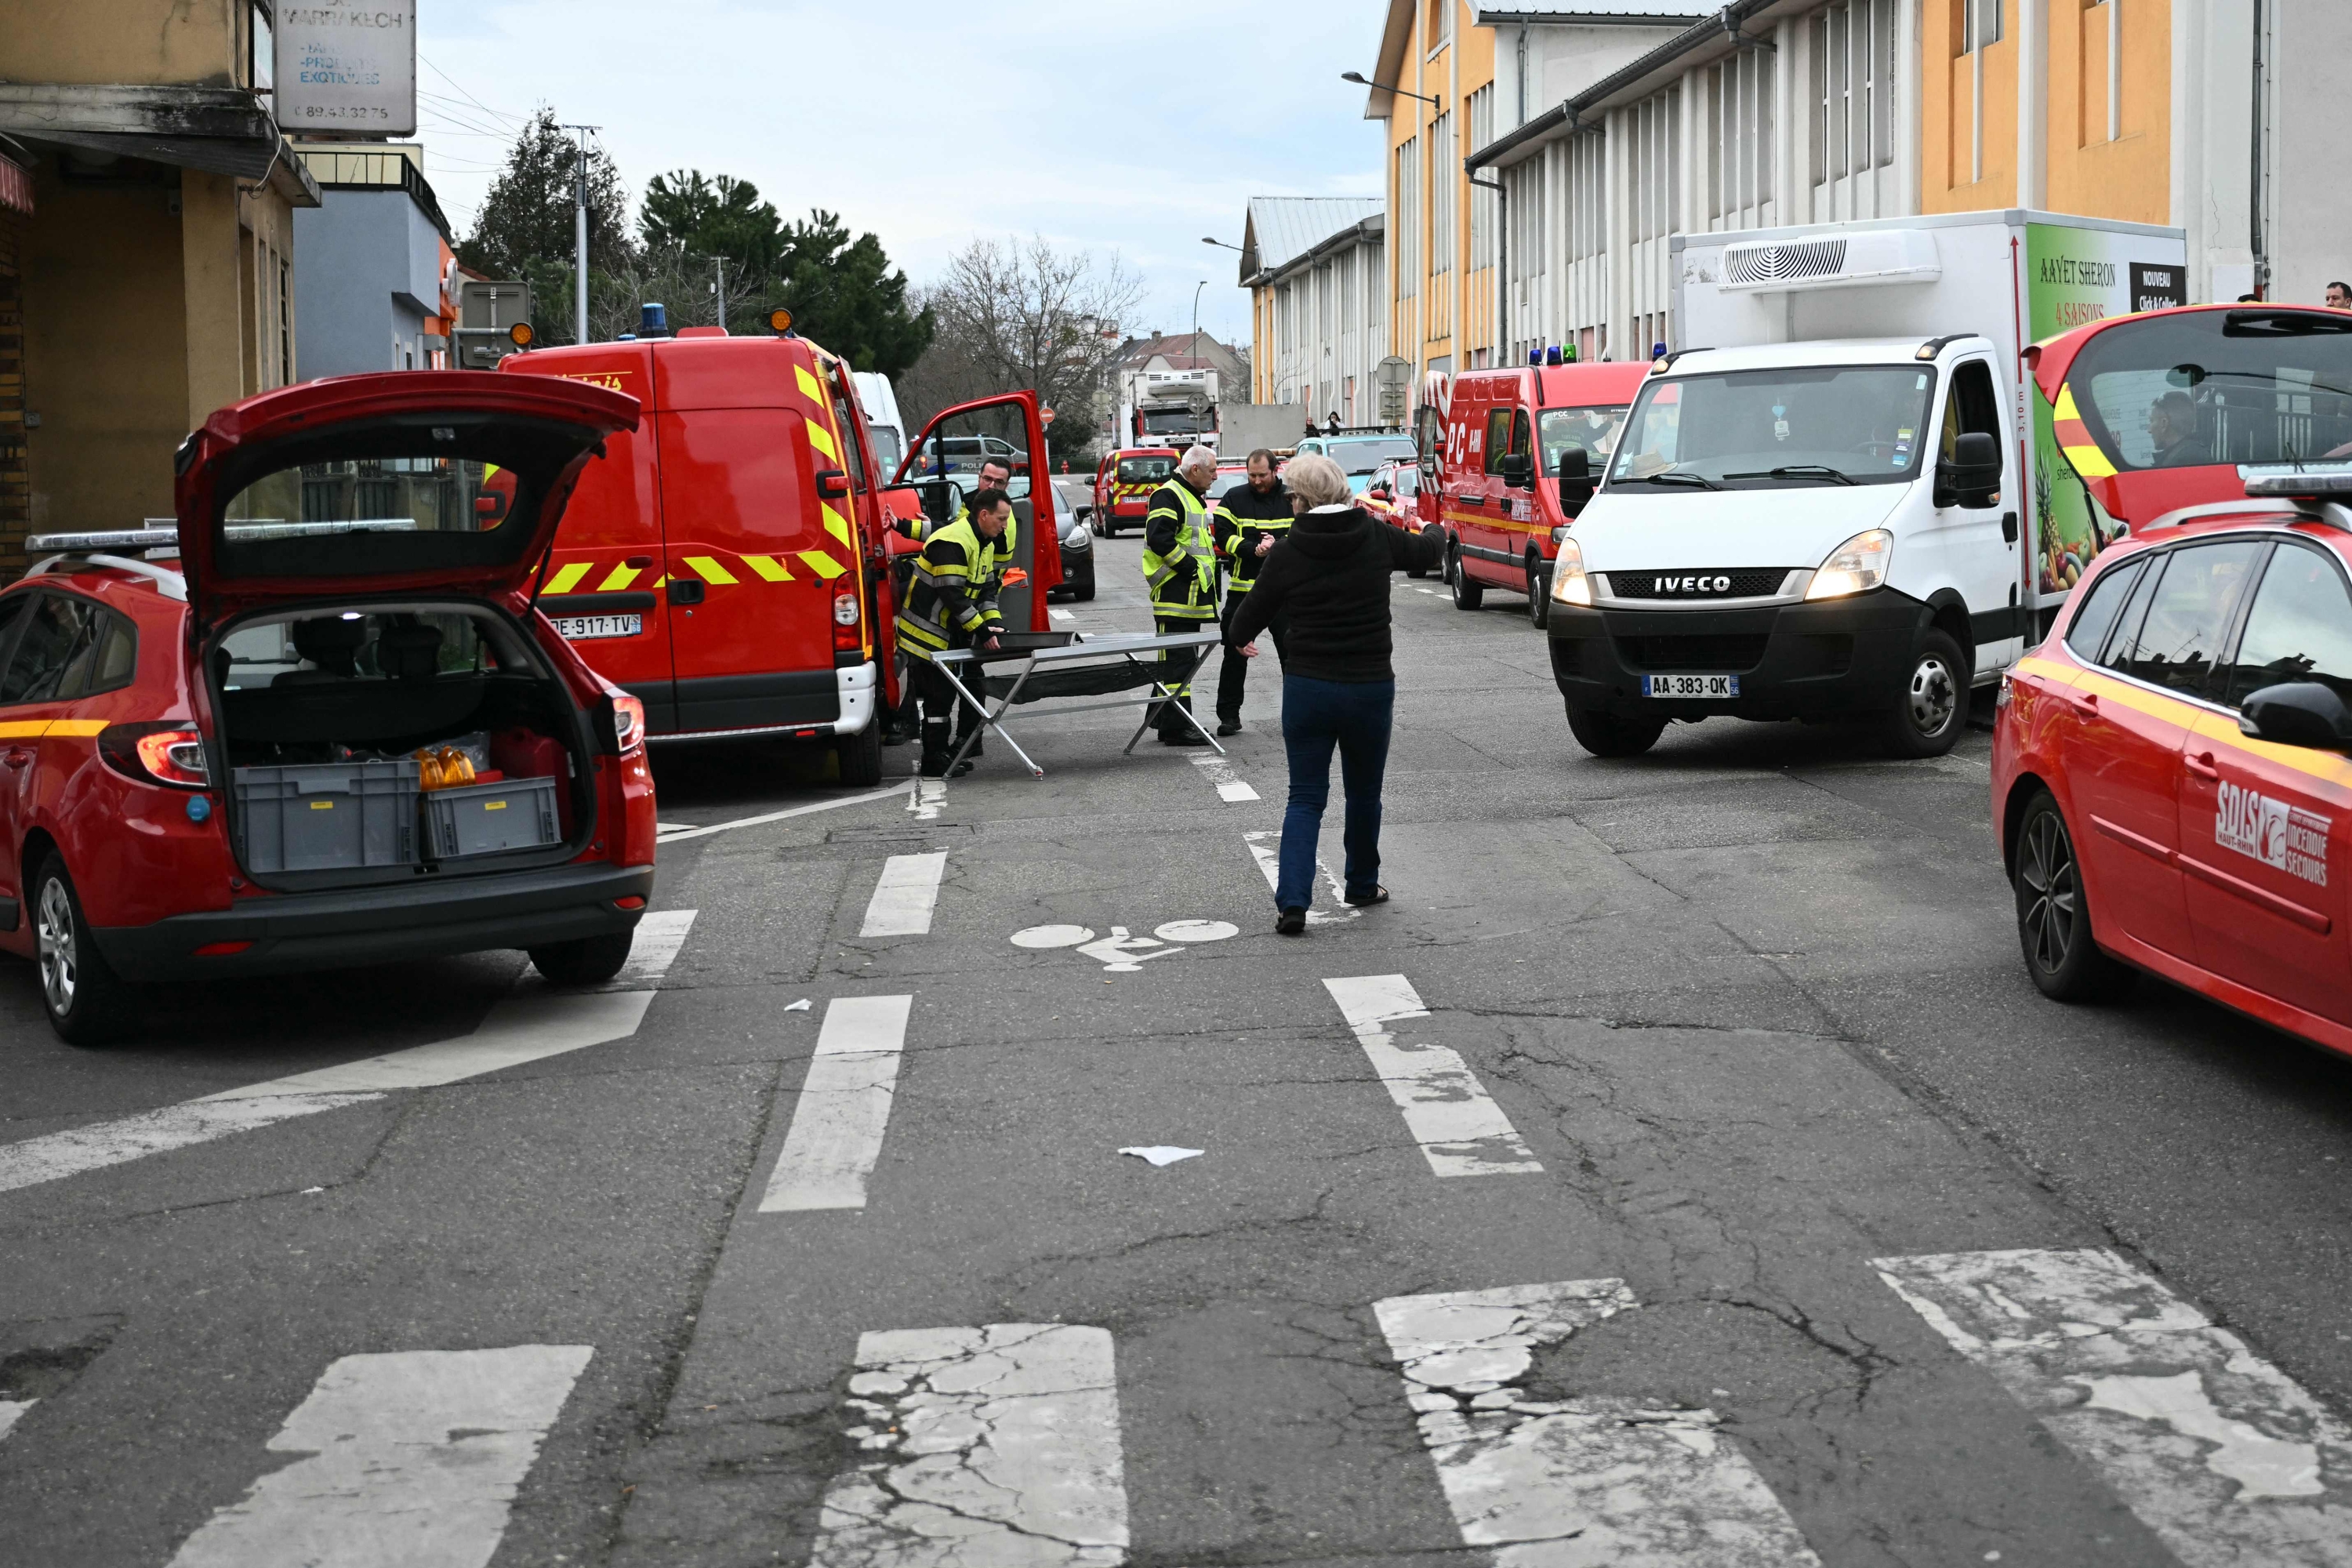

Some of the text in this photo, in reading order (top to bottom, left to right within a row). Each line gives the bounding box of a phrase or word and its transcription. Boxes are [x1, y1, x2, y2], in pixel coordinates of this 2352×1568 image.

[2040, 254, 2116, 289] AAYET SHERON
[2143, 270, 2171, 288] NOUVEAU
[2056, 303, 2104, 326] 4 SAISONS
[2140, 295, 2153, 311] Click
[2018, 391, 2024, 401] m
[1446, 422, 1465, 465] PC
[1654, 576, 1730, 593] IVECO
[1653, 677, 1728, 694] AA-383-QK
[2216, 780, 2259, 839] SDIS
[2218, 831, 2254, 855] HAUT-RHIN
[2288, 823, 2327, 860] INCENDIE
[2286, 851, 2327, 887] SECOURS
